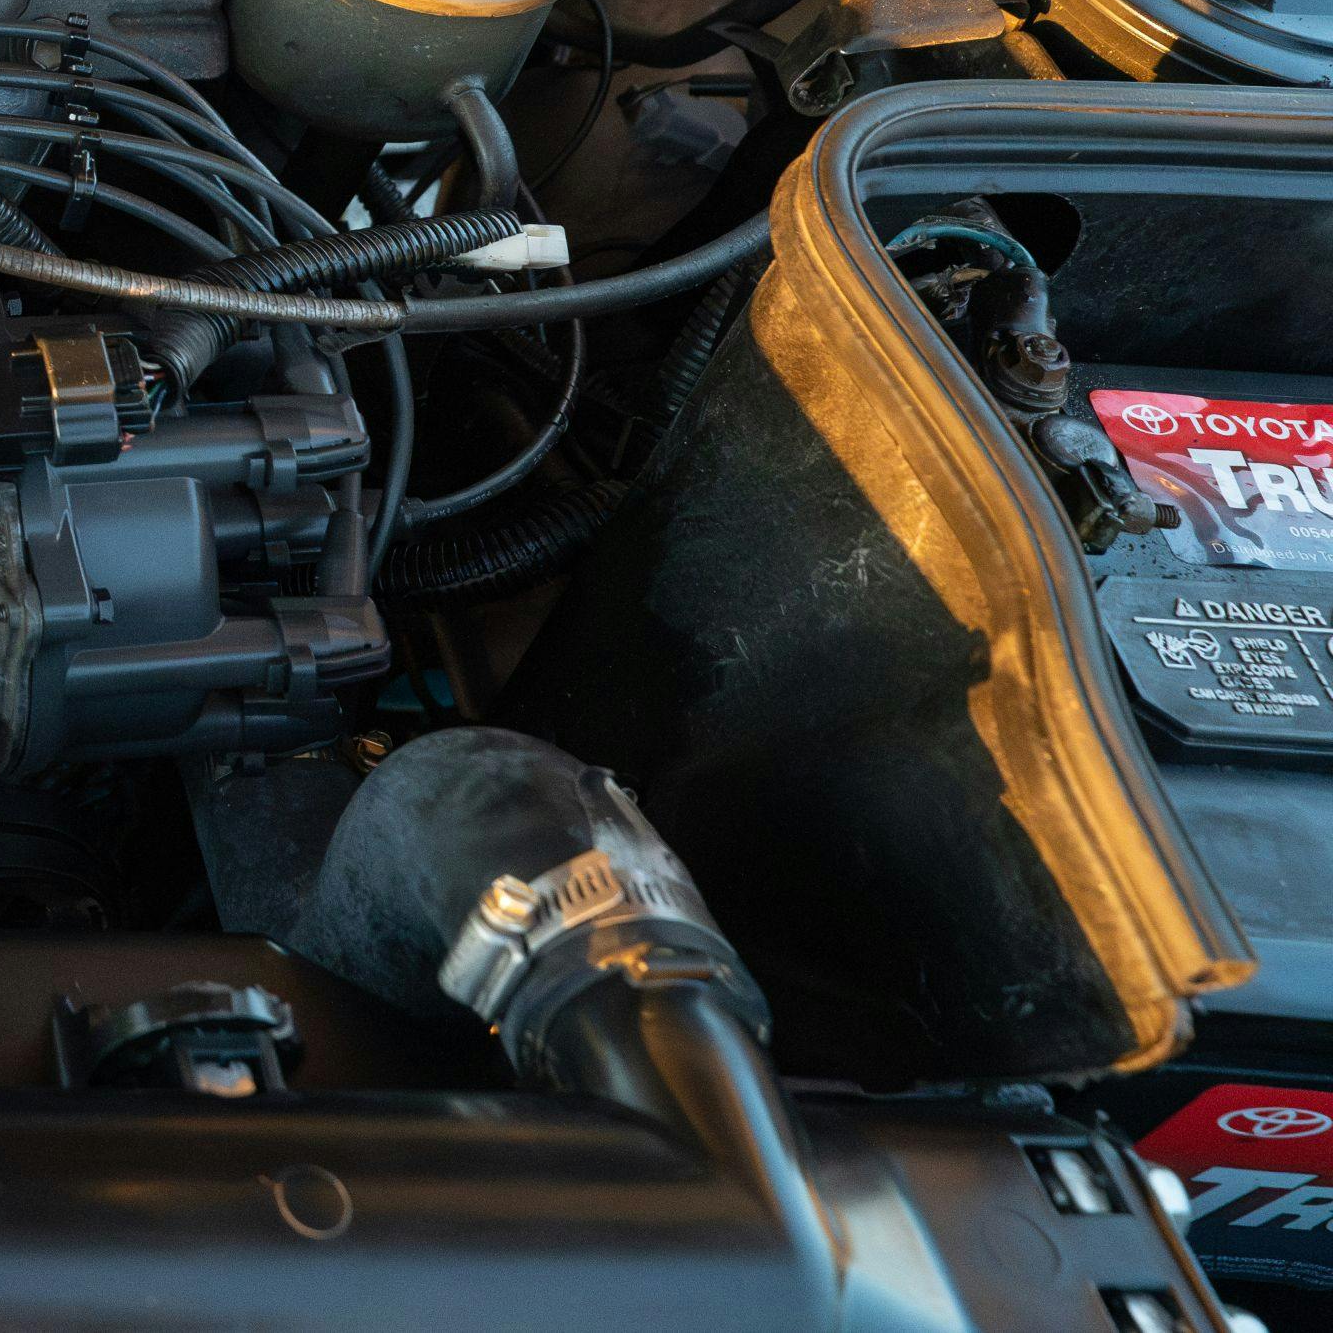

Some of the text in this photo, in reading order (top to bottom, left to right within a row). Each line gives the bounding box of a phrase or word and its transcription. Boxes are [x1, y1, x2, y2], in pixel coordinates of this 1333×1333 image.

[1179, 412, 1333, 443] TOYOTA
[1201, 600, 1327, 626] DANGER
[1231, 636, 1288, 652] SHIELD
[1237, 650, 1282, 665] EYES
[1210, 662, 1298, 679] EXPLOSIVE
[1189, 1166, 1333, 1232] TR
